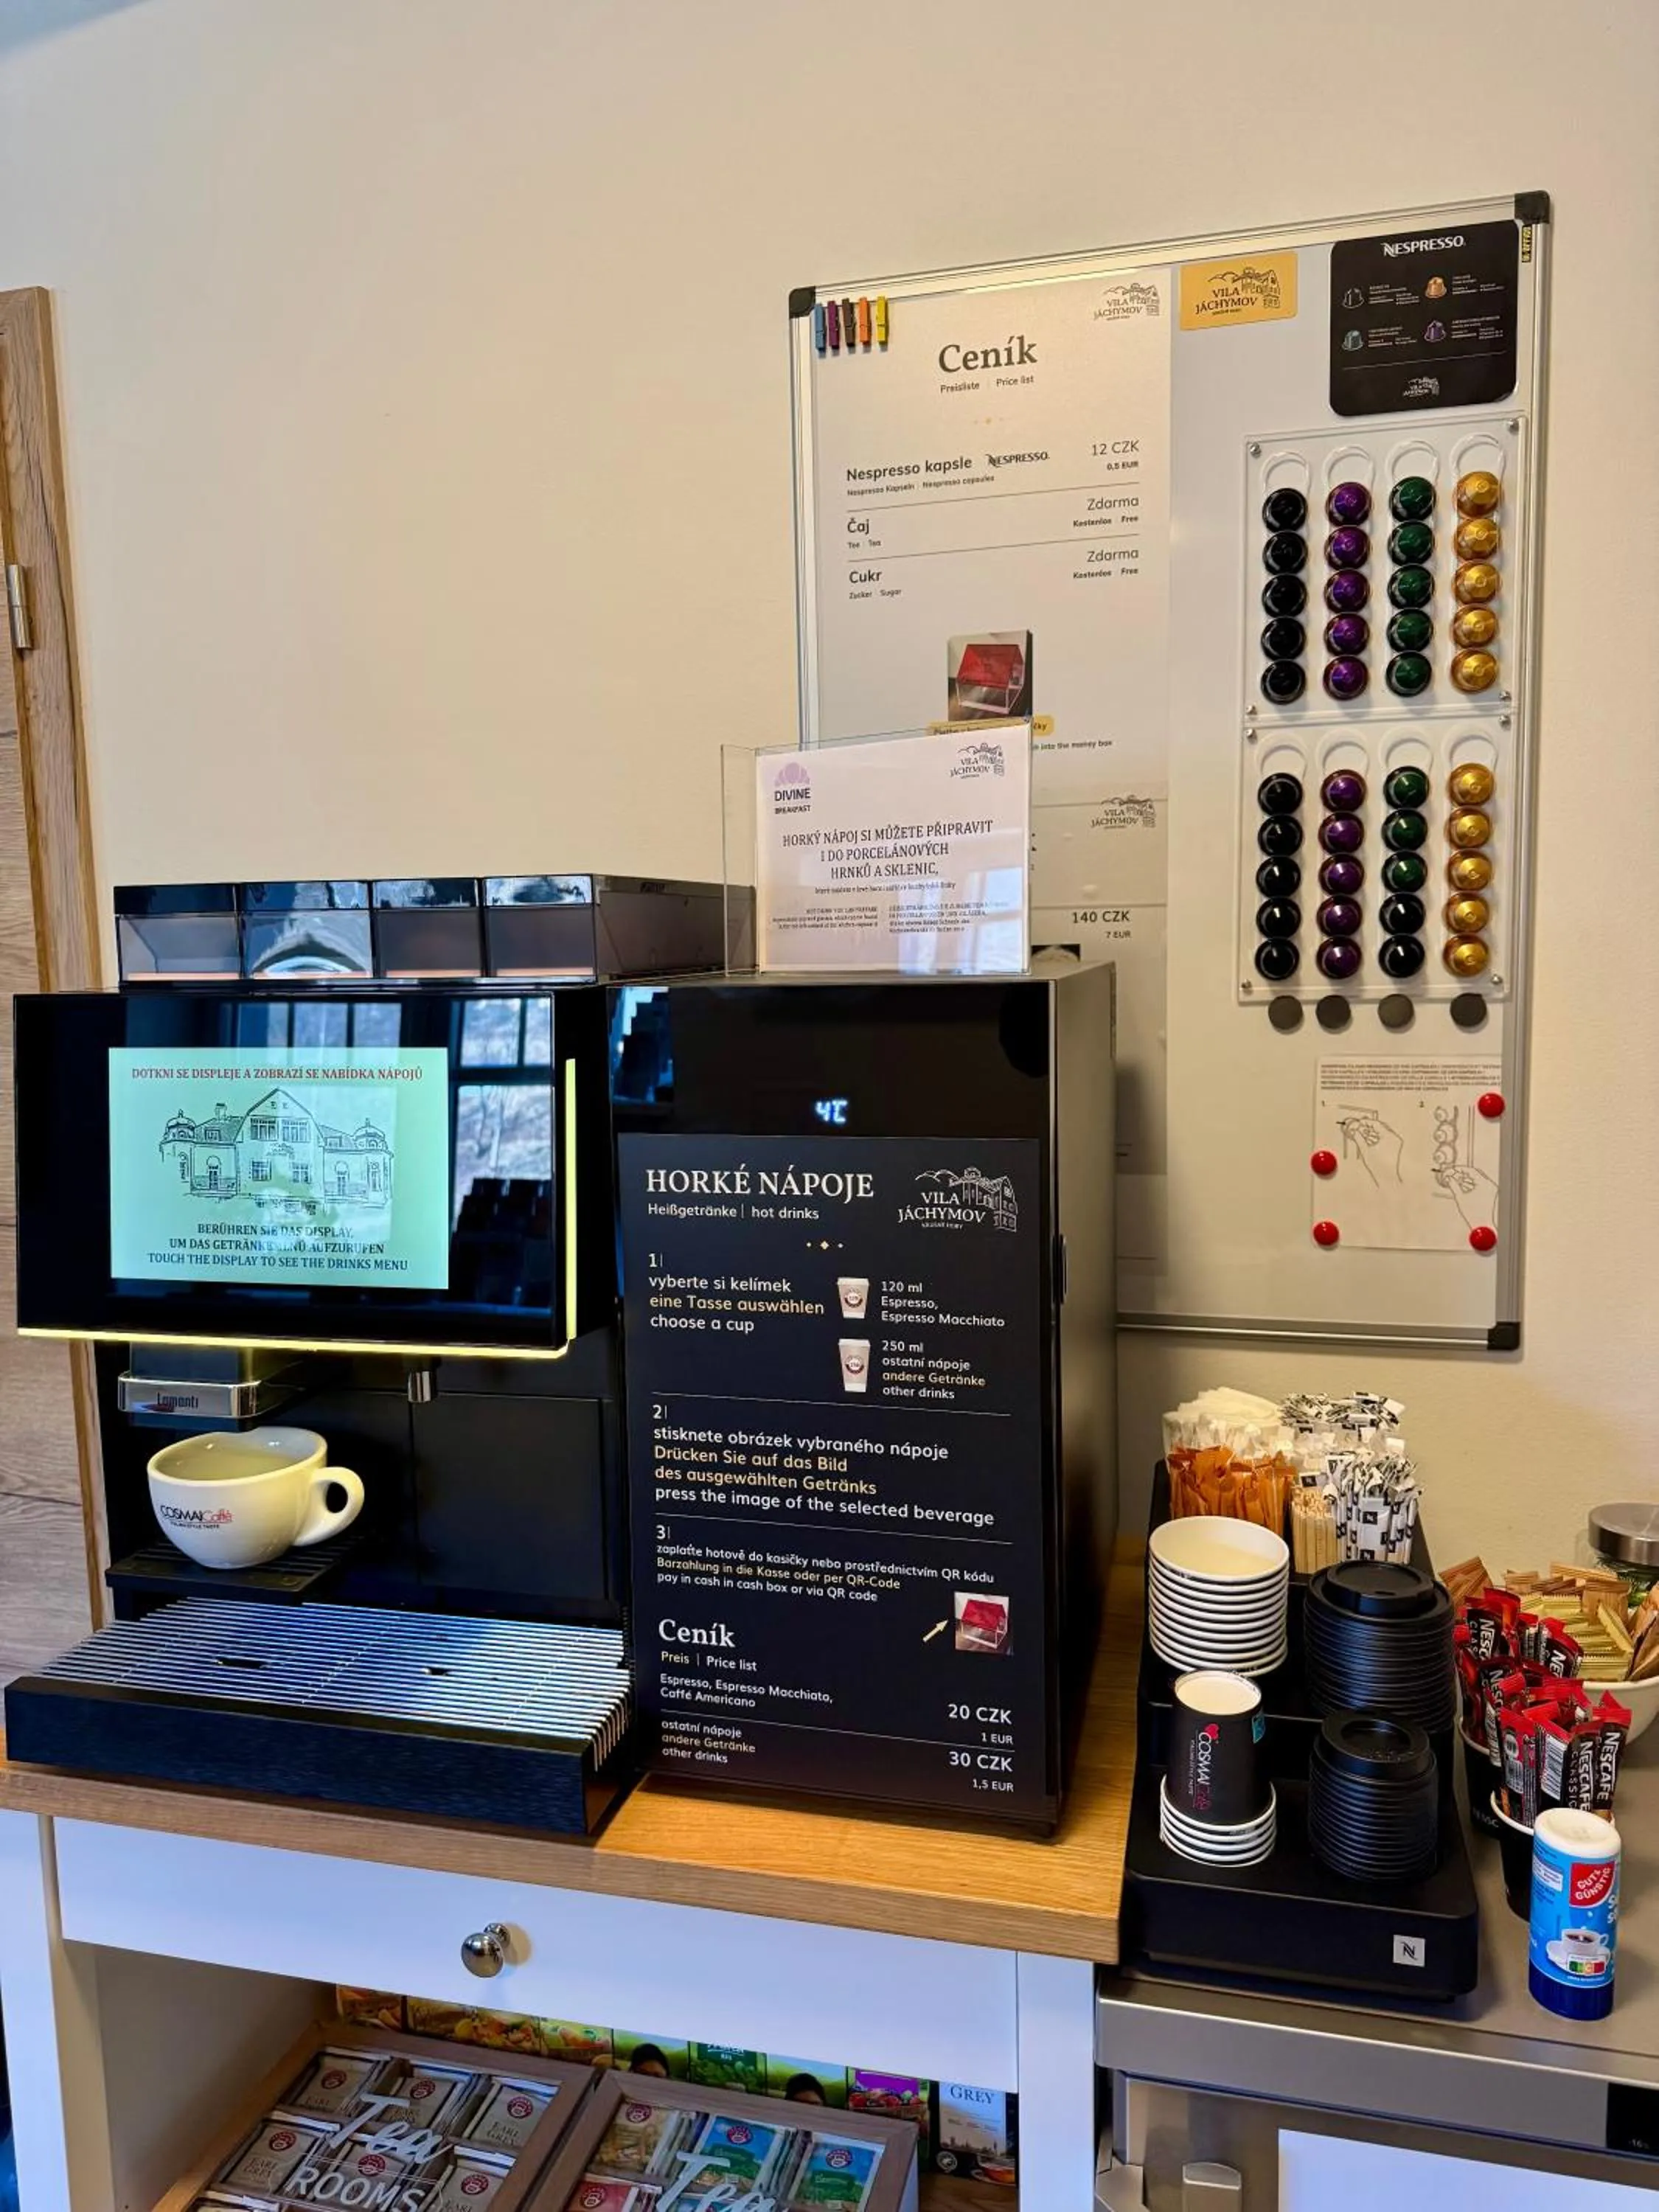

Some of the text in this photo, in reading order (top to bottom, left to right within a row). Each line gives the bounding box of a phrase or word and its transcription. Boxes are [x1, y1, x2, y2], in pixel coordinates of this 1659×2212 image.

[1382, 236, 1464, 257] NESPRESSO
[1212, 288, 1240, 297] VILA
[1107, 299, 1129, 307] VILA
[1196, 297, 1258, 315] JÁCHYMOV
[1093, 307, 1143, 320] JÁCHYMOV
[939, 335, 1038, 372] Ceník
[940, 375, 1034, 393] Preisliste Price list
[1092, 441, 1139, 456] 12 CZK
[847, 456, 972, 481] Nespresso kapsle
[1107, 460, 1138, 470] 0,5 EUR
[1087, 495, 1139, 511] Zdarma
[847, 518, 870, 535] Čaj
[1074, 515, 1138, 528] Kostenlos Free
[849, 570, 882, 583] Cukr
[849, 588, 901, 599] Zucker Sugar
[960, 757, 978, 765] VILA
[774, 788, 810, 801] DIVINE
[775, 805, 810, 815] BREAKFAST
[1091, 816, 1139, 827] JÁCHYMOV
[783, 820, 993, 846] HORKÝ NÁPOJ SI MŮŽETE PŘIPRAVIT
[821, 843, 949, 861] I DO PORCELÁNOVÝCH
[831, 862, 939, 879] HRNKŮ A SKLENIC,
[1072, 911, 1130, 924] 140 CZK
[132, 1065, 422, 1081] DOTKNI SE DISPLEJE A ZOBRAZÍ SE NABÍDKA NÁPOJŮ
[646, 1164, 874, 1204] HORKÉ NÁPOJE
[921, 1192, 960, 1204] VILA
[648, 1203, 818, 1220] Heißgetränke hot drinks
[897, 1204, 986, 1223] JÁCHYMOV
[198, 1222, 257, 1236] BERÜHREN
[280, 1225, 302, 1237] DAS
[170, 1238, 186, 1249] UM
[189, 1239, 210, 1250] DAS
[310, 1242, 384, 1255] AUFZURUFEN
[149, 1252, 408, 1270] TOUCH THE DISPLAY TO SEE THE DRINKS MENU
[649, 1274, 790, 1293] vyberte si kelímek
[882, 1281, 922, 1293] 120 ml
[650, 1295, 824, 1315] eine Tasse auswählen
[881, 1296, 938, 1311] Espresso,
[650, 1315, 754, 1334] choose a cup
[881, 1311, 1005, 1327] Espresso Macchiato
[883, 1340, 923, 1353] 250 ml
[883, 1356, 970, 1371] ostatní nápoje
[883, 1371, 986, 1386] andere Getränke
[883, 1385, 954, 1399] other drinks
[654, 1427, 948, 1461] stisknete obrázek vybraného nápoje
[655, 1446, 847, 1472] Drücken Sie auf das Bild
[655, 1467, 876, 1495] des ausgewählten Getränks
[657, 1543, 994, 1583] zaplaťte hotově do kasičky nebo prostřednictvím QR kódu
[658, 1619, 735, 1648] Ceník
[661, 1651, 757, 1672] Preis Price list
[660, 1674, 832, 1703] Espresso, Espresso Macchiato,
[695, 1691, 755, 1707] Americano
[948, 1704, 1012, 1725] 20 CZK
[981, 1732, 1013, 1745] 1 EUR
[949, 1751, 1012, 1772] 30 CZK
[973, 1778, 1014, 1792] 1,5 EUR
[950, 2084, 994, 2104] GREY
[325, 2092, 455, 2164] Tea
[285, 2166, 426, 2212] ROOMS
